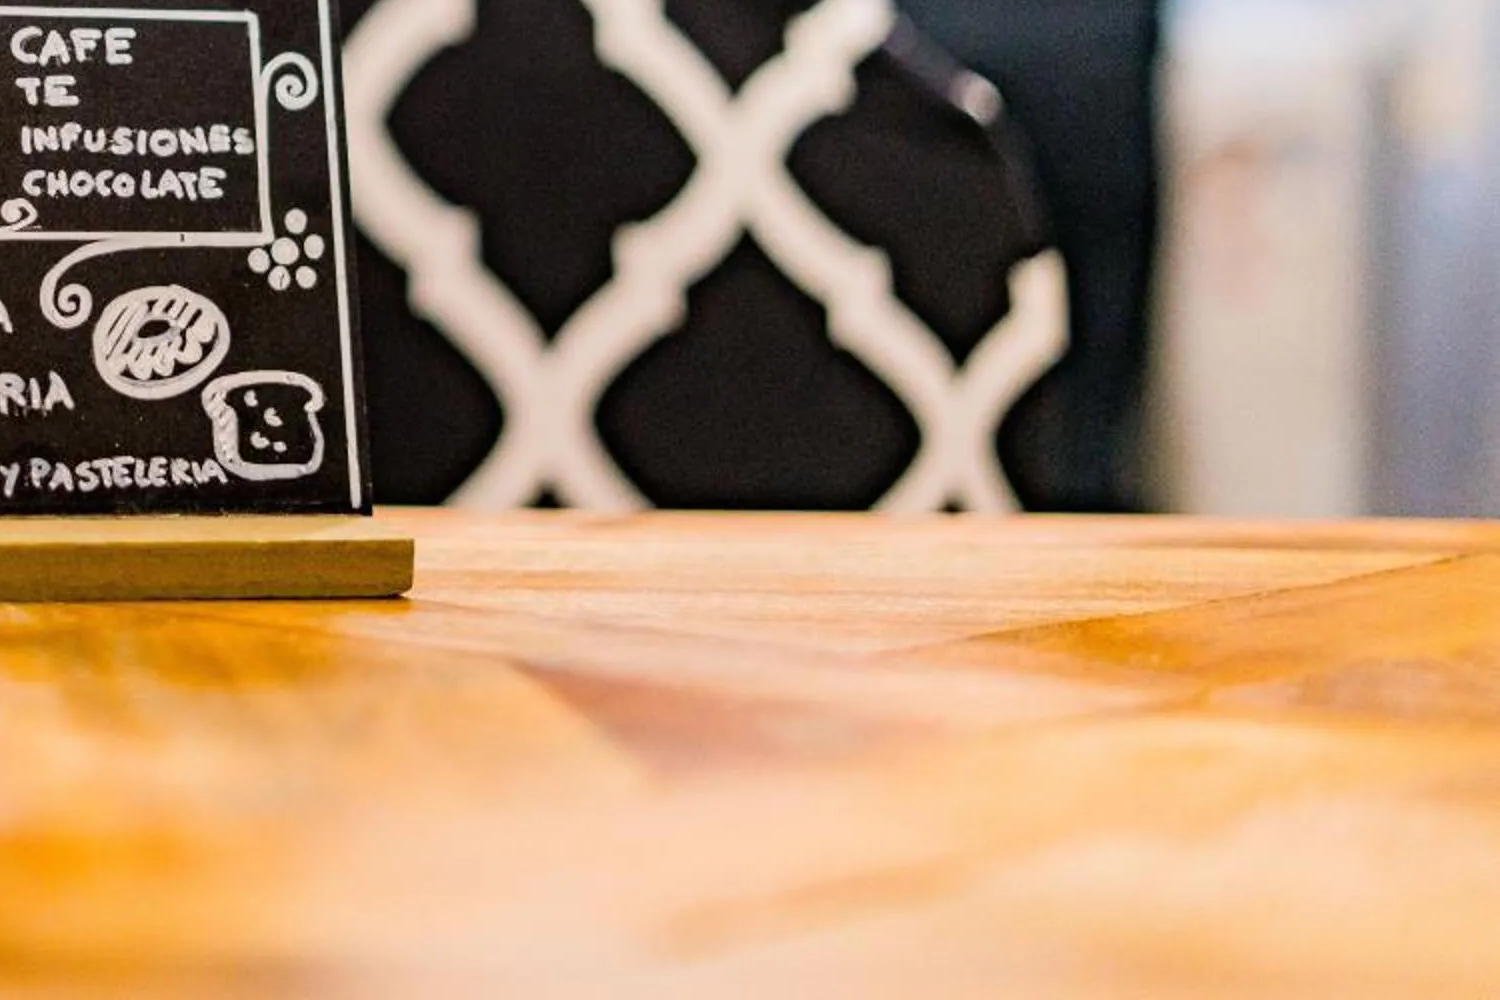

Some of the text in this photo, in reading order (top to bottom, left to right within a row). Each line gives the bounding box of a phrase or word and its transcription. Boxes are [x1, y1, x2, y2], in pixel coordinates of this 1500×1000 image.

[9, 27, 137, 66] CAFE
[15, 75, 80, 107] TE
[20, 122, 256, 157] INFUSIONES
[21, 167, 227, 200] CHOCOLATE
[29, 456, 228, 494] PASTELERIA
